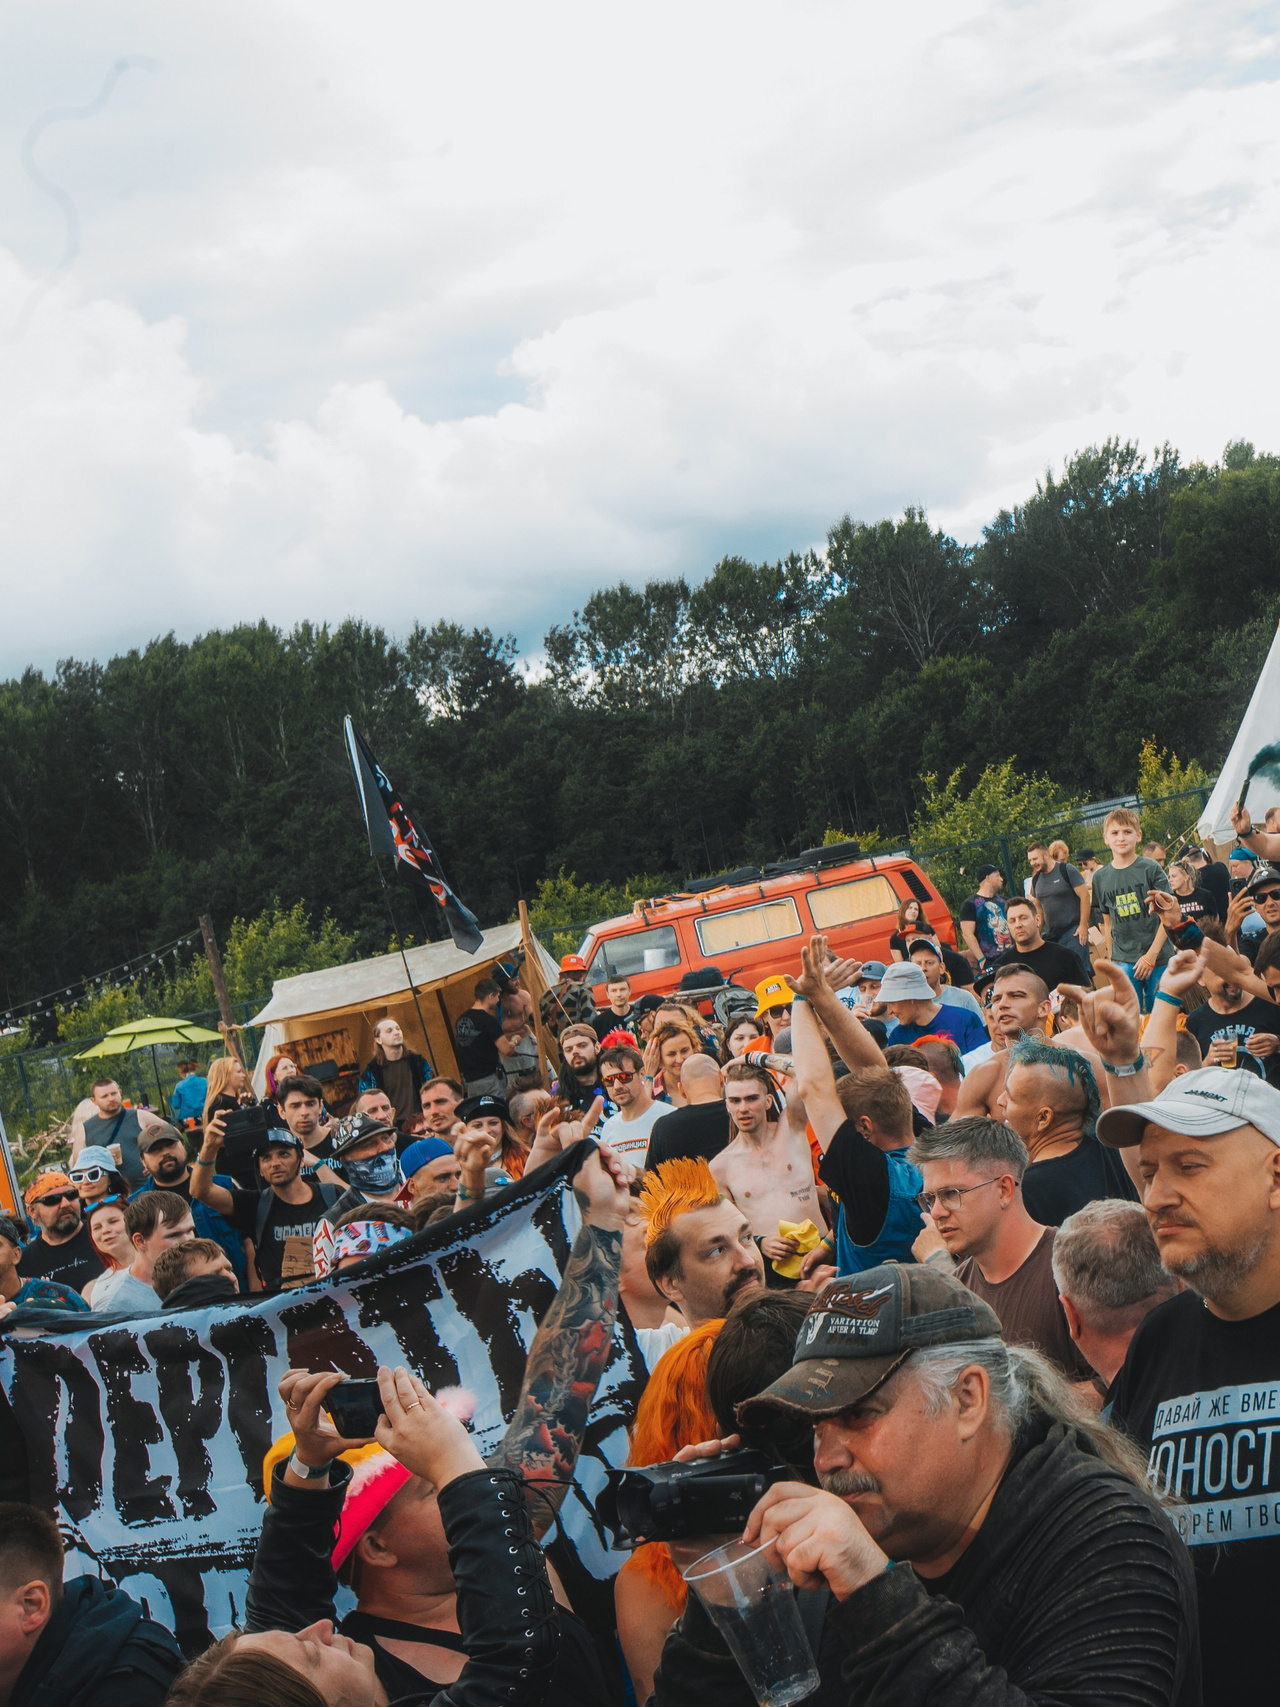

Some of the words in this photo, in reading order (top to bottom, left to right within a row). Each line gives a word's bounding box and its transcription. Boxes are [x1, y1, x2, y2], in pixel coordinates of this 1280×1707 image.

[830, 1317, 880, 1328] VARIATION
[1155, 1397, 1201, 1430] ДАВАЙ
[1208, 1394, 1231, 1418] ЖЕ
[1171, 1508, 1233, 1536] СРЁМ
